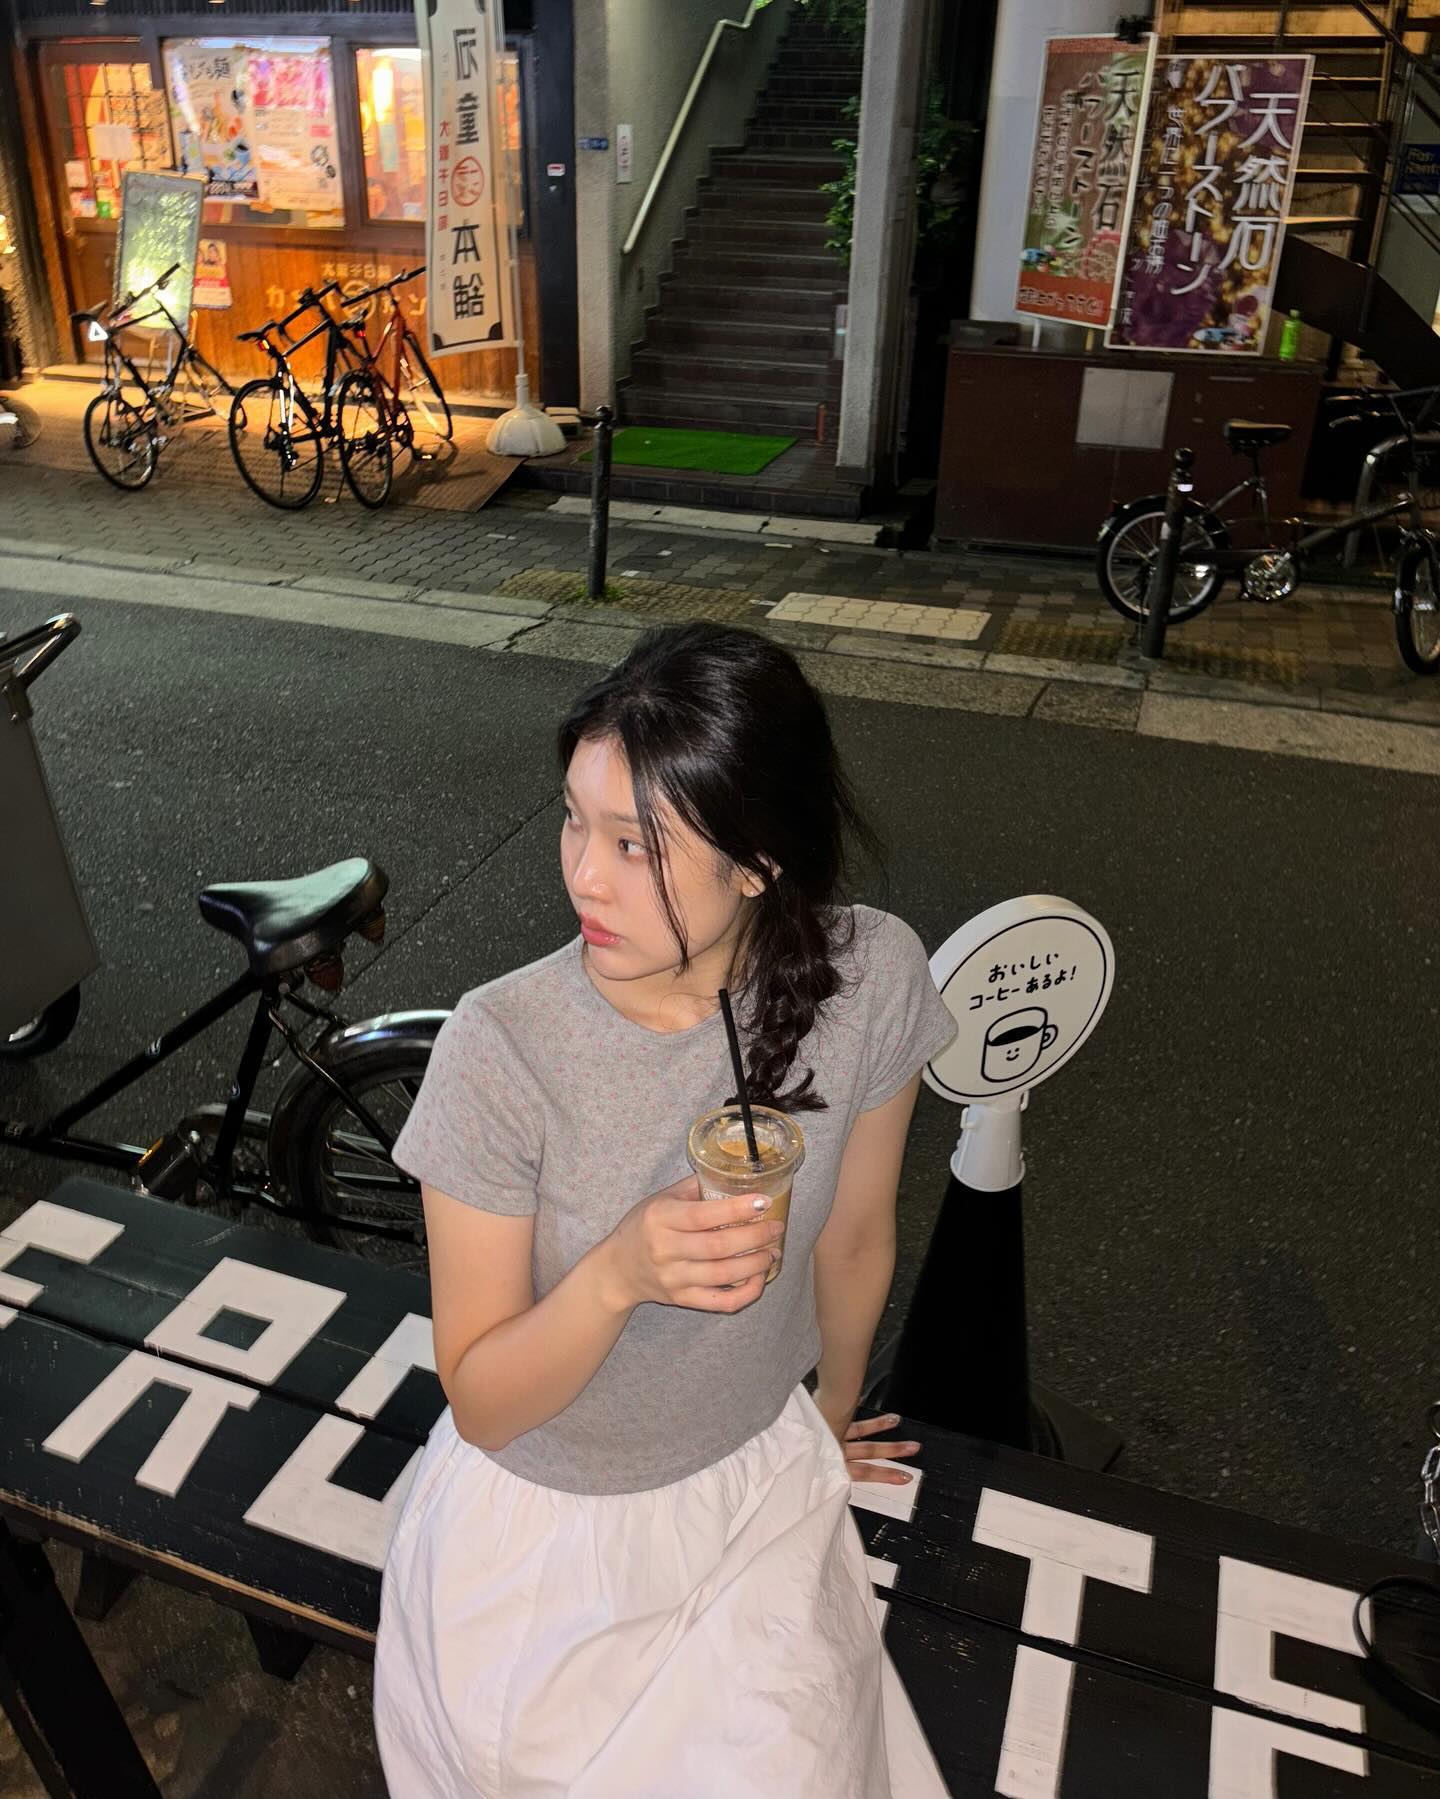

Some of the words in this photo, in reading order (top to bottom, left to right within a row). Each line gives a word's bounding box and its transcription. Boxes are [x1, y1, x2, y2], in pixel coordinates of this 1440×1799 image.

[1093, 70, 1142, 231] 天然石
[1218, 92, 1301, 272] 天然石
[988, 953, 1060, 984] おいしい
